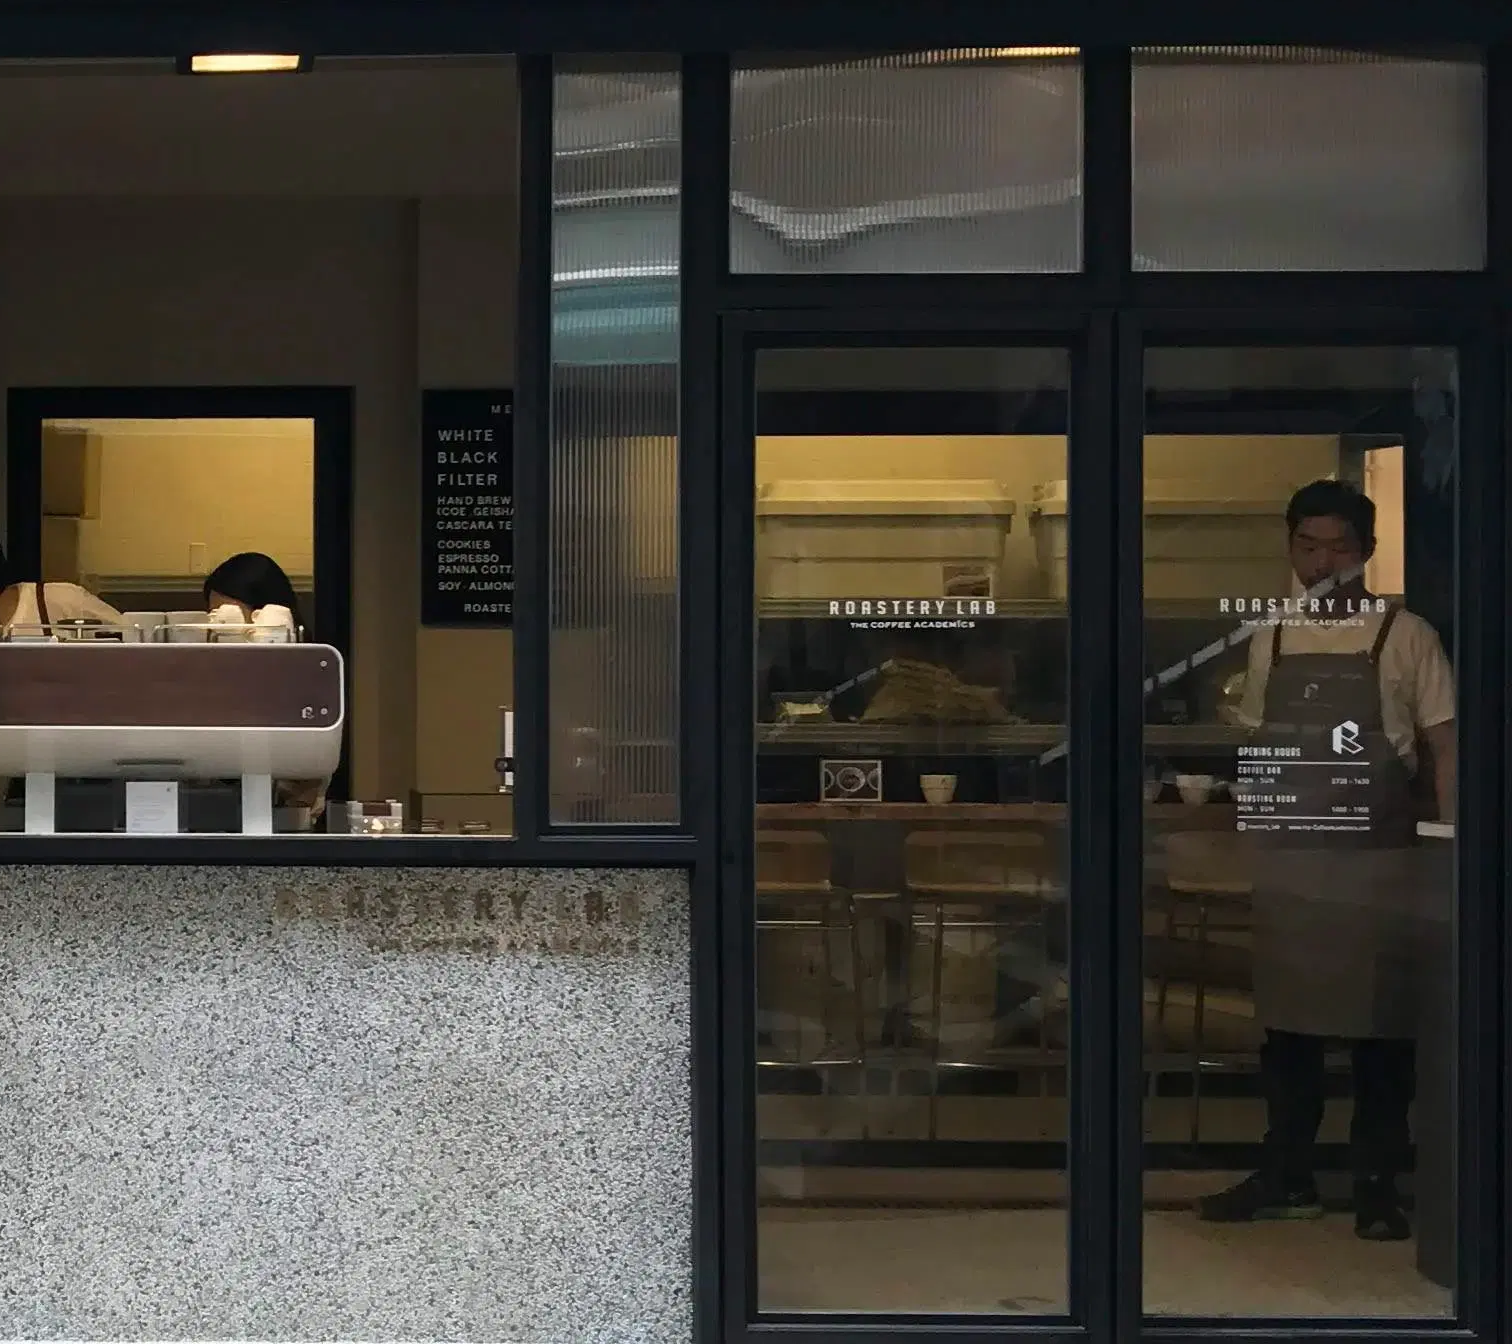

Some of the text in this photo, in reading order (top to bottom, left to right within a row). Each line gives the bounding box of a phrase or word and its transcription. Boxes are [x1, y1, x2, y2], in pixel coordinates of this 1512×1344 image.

[437, 429, 494, 441] WHITE
[437, 452, 498, 464] BLACK
[437, 474, 498, 486] FILTER
[437, 496, 512, 505] HAND BREW
[436, 521, 495, 530] CASCARA
[437, 540, 491, 549] COOKIES
[438, 554, 500, 563] ESPRESSO
[438, 564, 515, 574] PANNA COTT
[438, 581, 462, 591] SOY
[829, 600, 996, 615] ROASTERY LAB
[1219, 598, 1386, 613] ROASTERY LAB
[870, 621, 912, 629] COFFEE
[1237, 746, 1272, 757] OPENING
